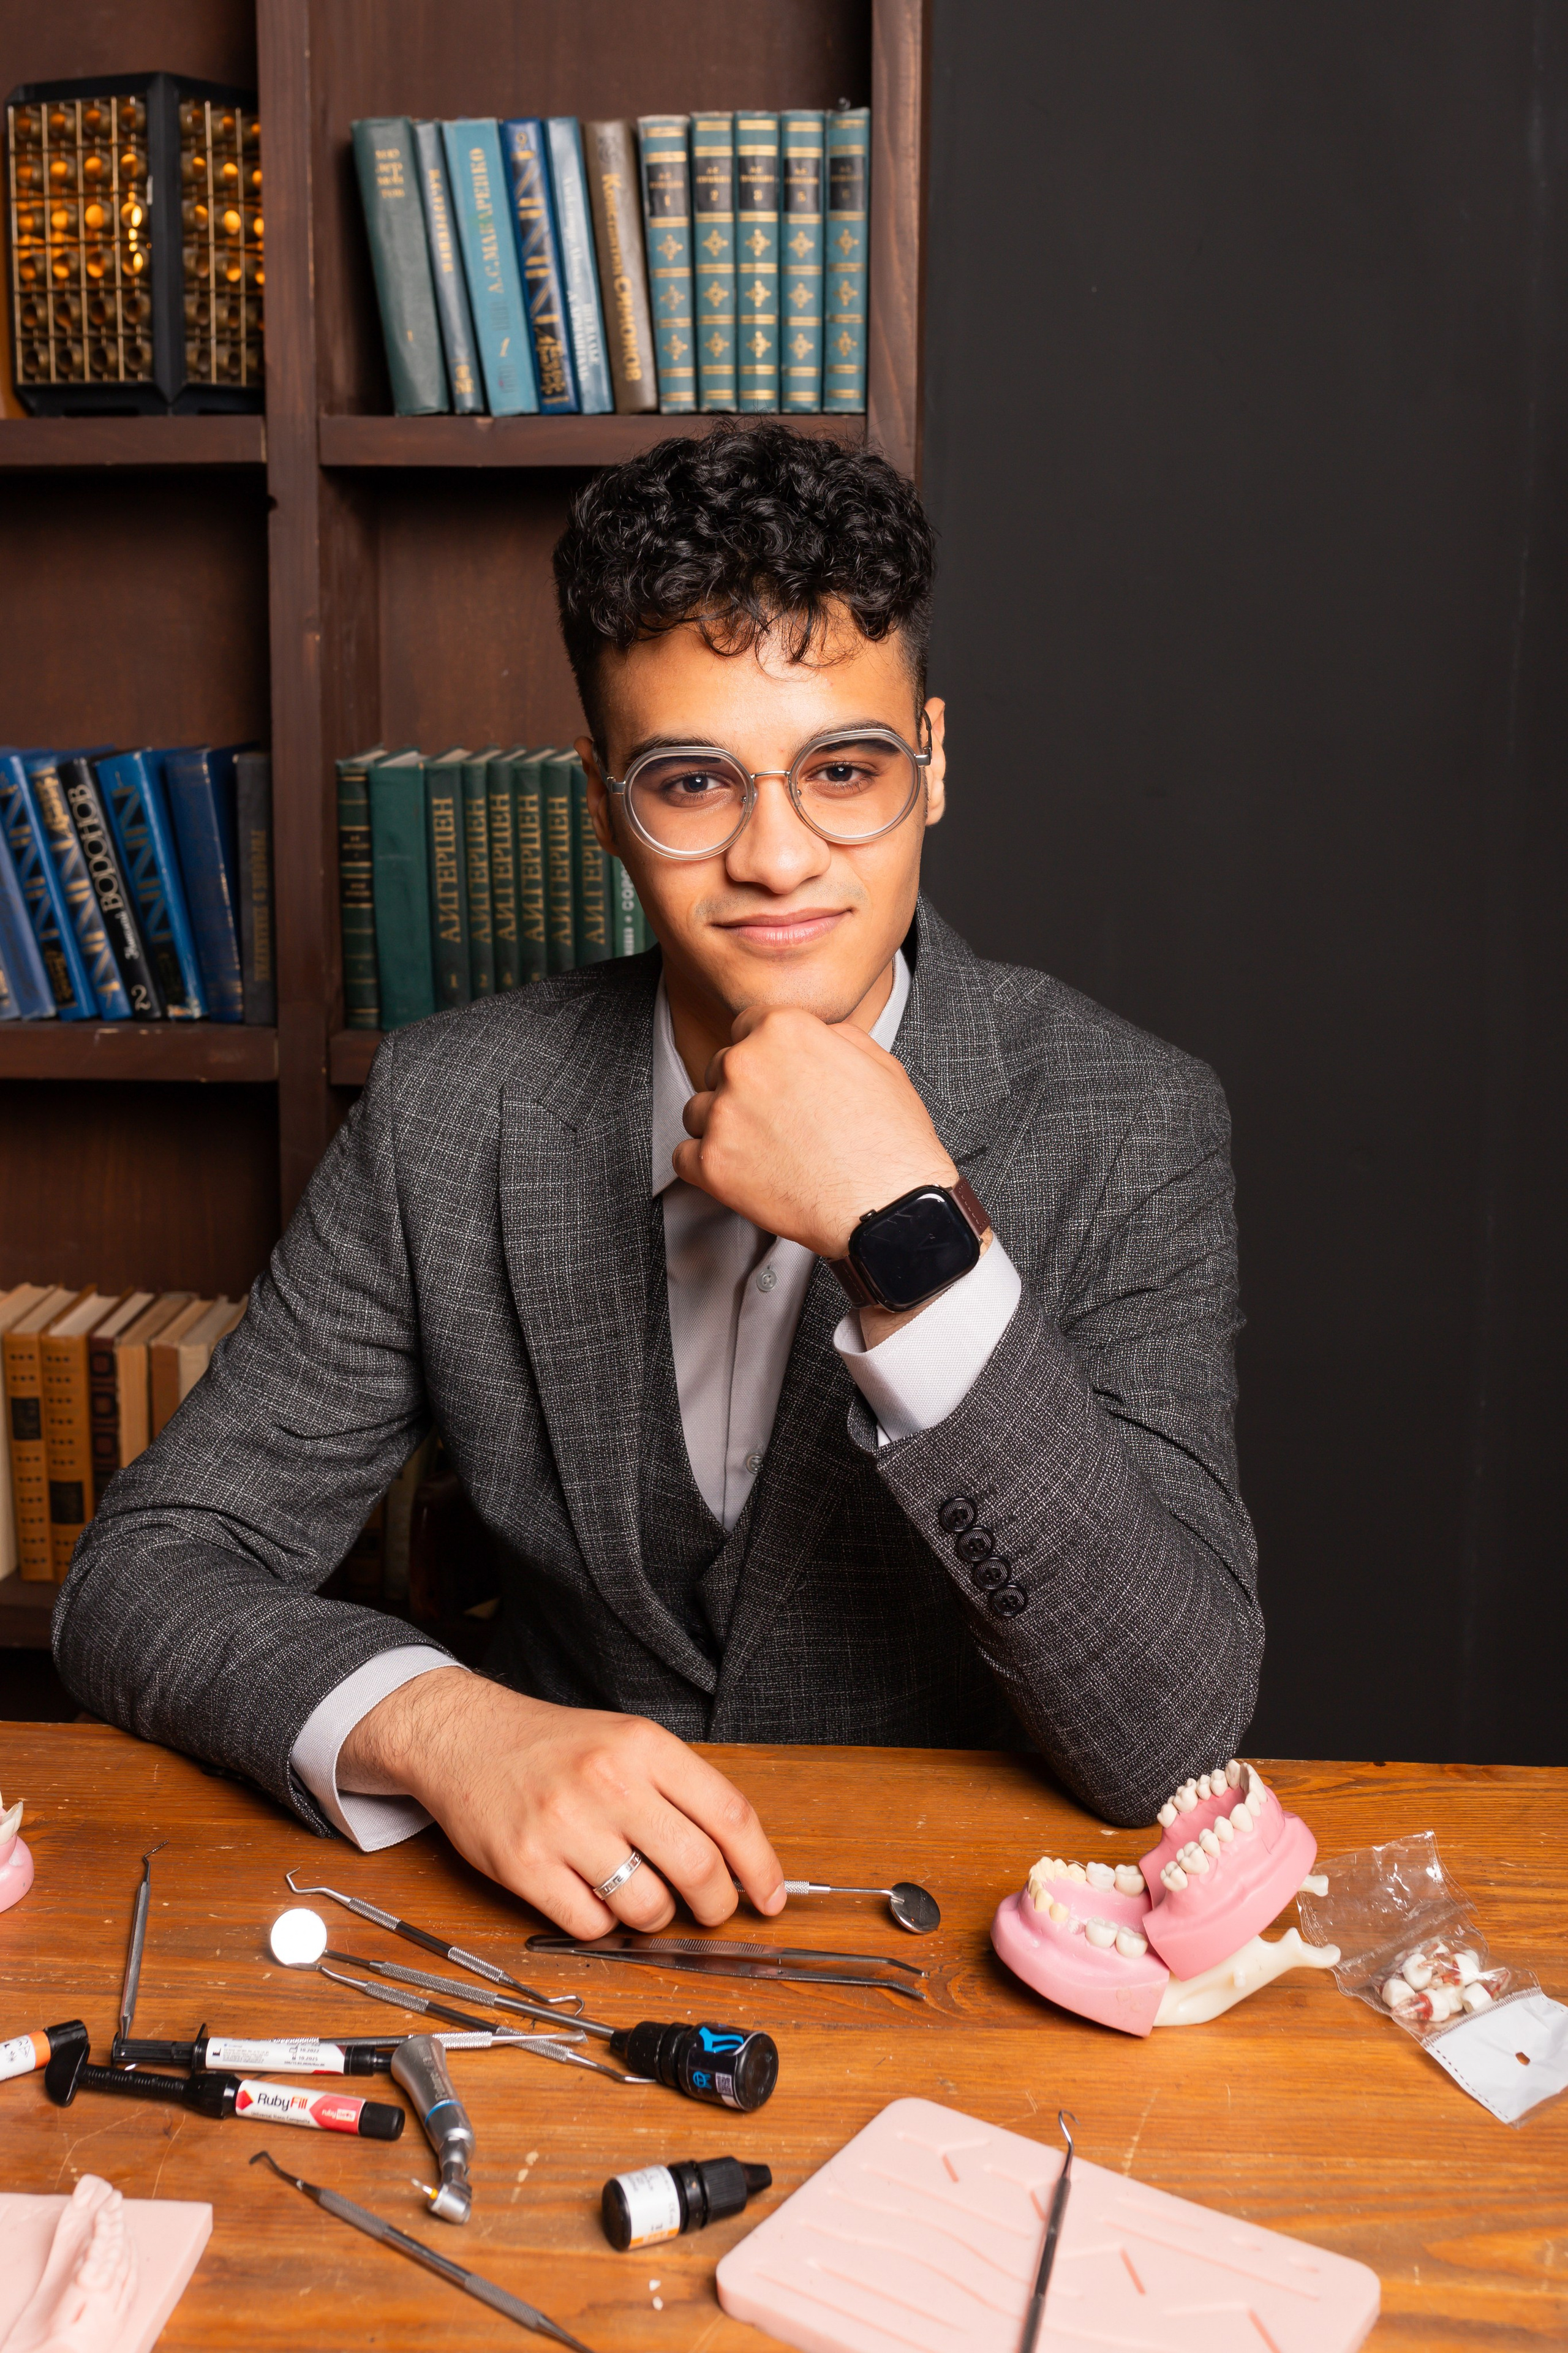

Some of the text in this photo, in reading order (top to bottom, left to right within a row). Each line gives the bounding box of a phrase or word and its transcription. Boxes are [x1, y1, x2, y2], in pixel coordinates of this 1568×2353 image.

[614, 275, 643, 382] СИМОНОВ
[499, 337, 511, 358] 1
[68, 784, 123, 913] ВОРОНОВ
[130, 984, 151, 1011] 2
[258, 2093, 308, 2112] RubyFill
